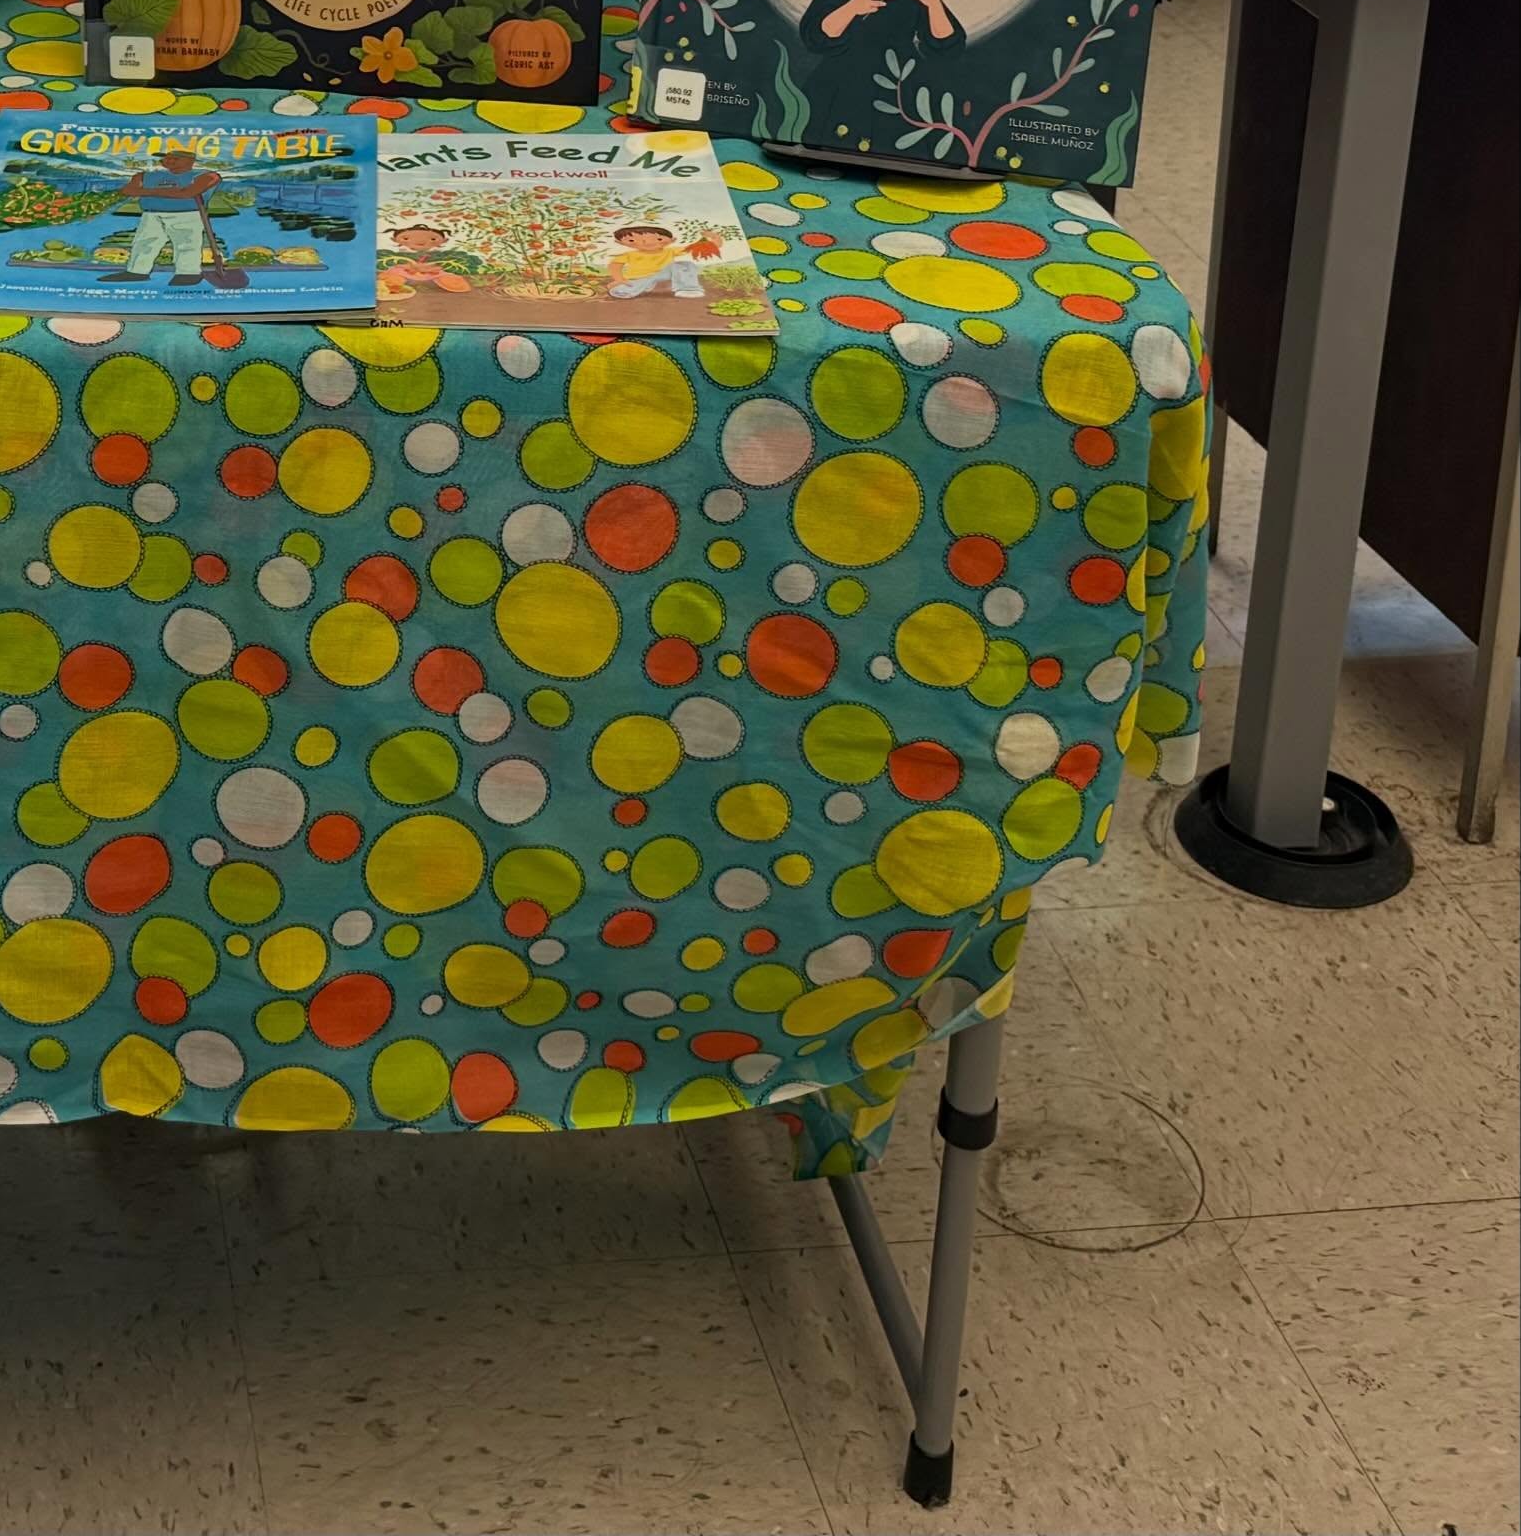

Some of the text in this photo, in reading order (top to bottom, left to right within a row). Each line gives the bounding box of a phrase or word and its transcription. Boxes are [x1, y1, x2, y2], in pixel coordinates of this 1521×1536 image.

[319, 7, 361, 22] CYCLE
[724, 83, 738, 91] BY
[707, 93, 751, 106] BRISEÑO
[60, 123, 146, 135] Farmer
[150, 126, 204, 136] Will
[210, 127, 275, 136] Allen
[1008, 117, 1100, 137] ILLUSTRATED BY
[20, 128, 346, 161] GROWING TABLE
[1010, 132, 1095, 151] ISABEL MUÑOZ
[377, 140, 702, 178] lants Feed Me
[451, 168, 609, 180] Lizzy Rockwell
